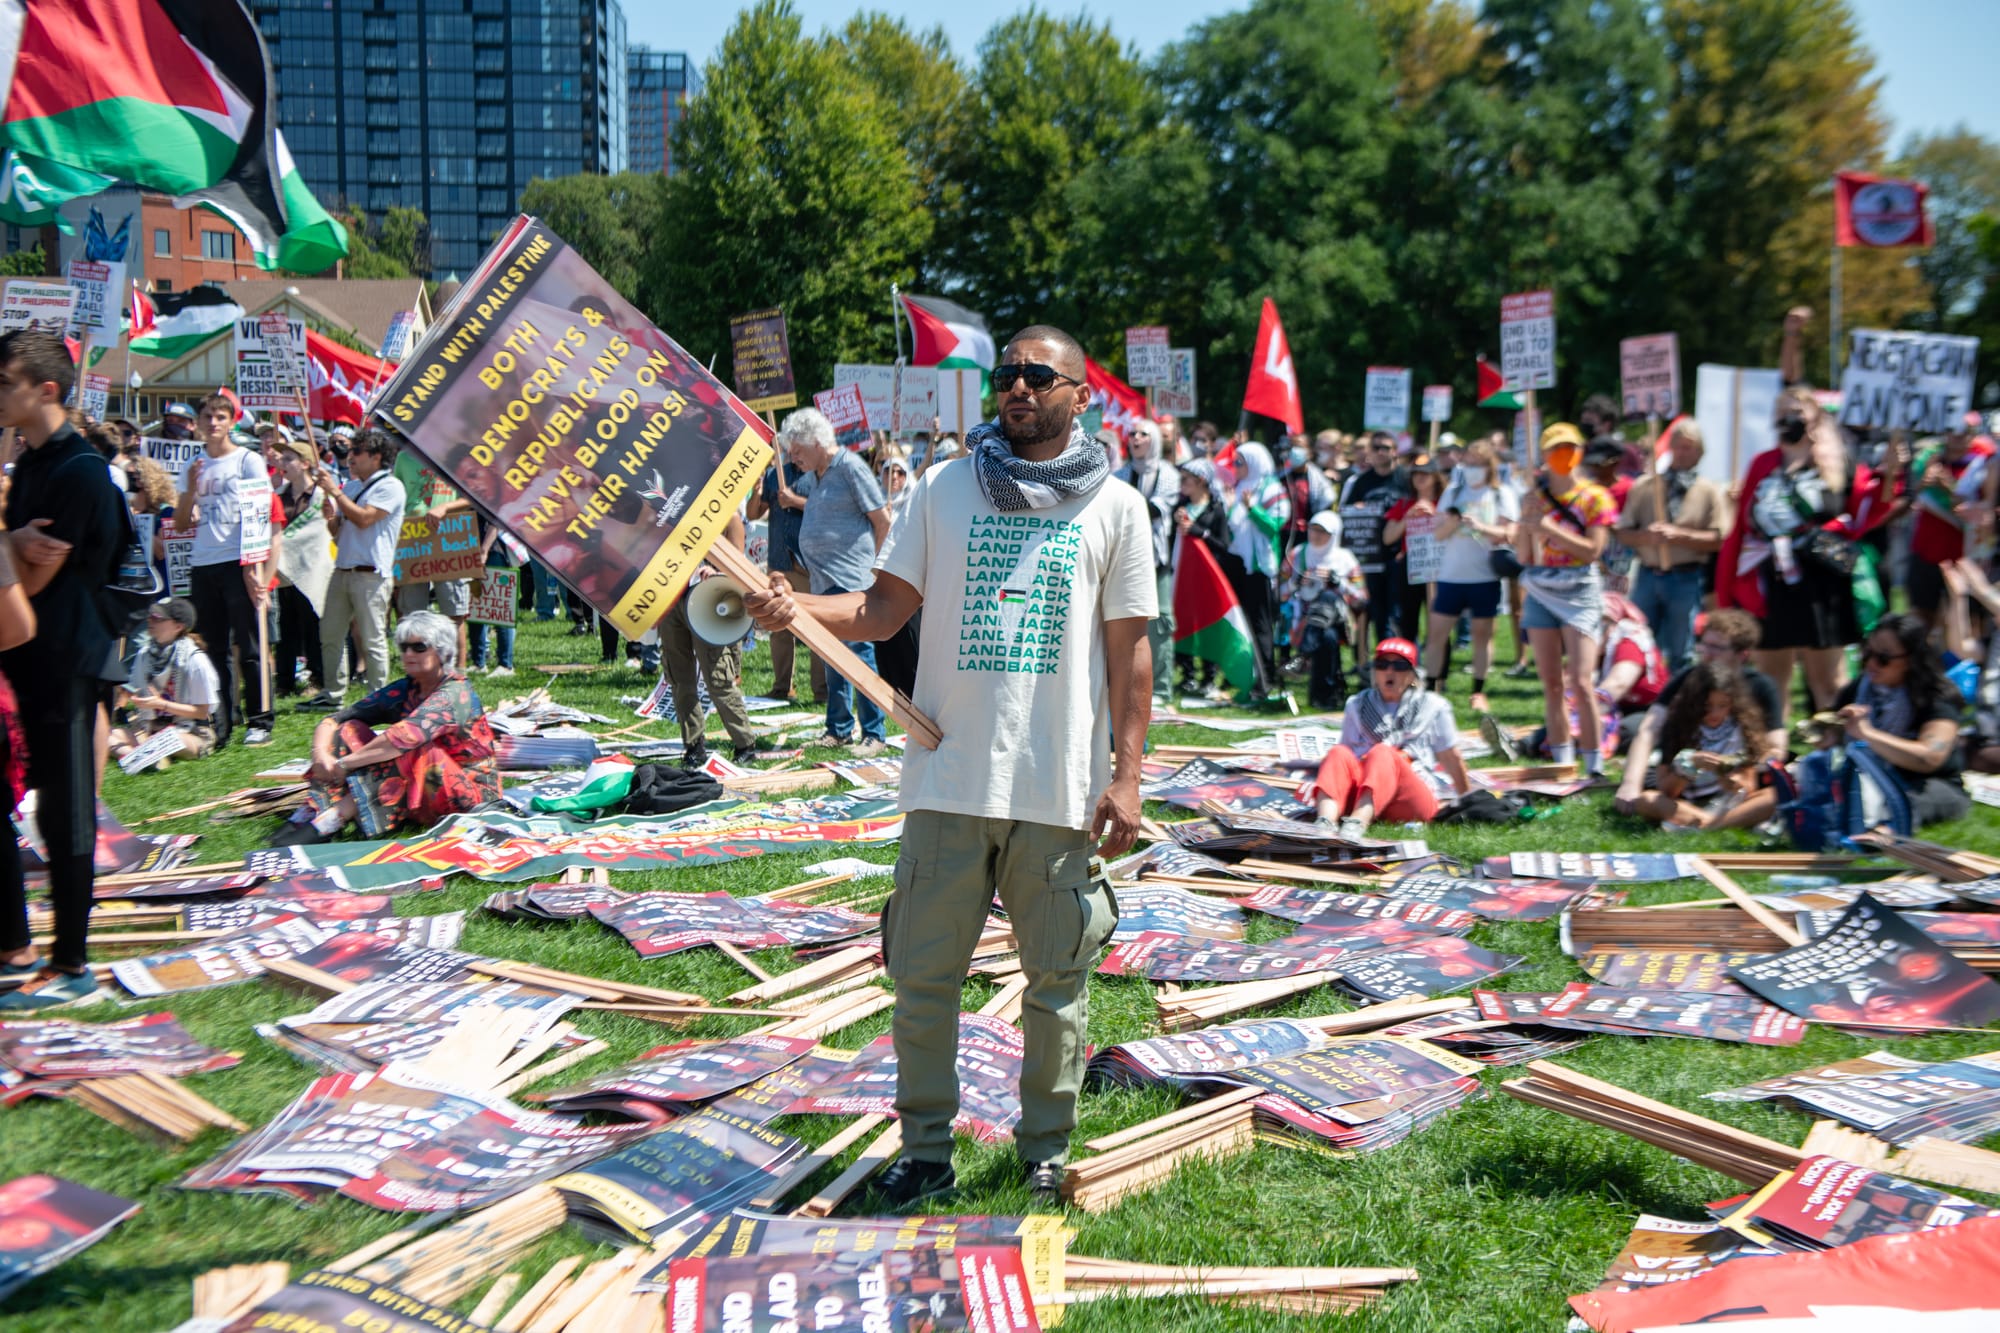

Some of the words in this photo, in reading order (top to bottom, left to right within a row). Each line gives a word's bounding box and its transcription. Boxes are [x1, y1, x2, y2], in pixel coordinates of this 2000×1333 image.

[2, 310, 30, 319] STOP
[394, 363, 447, 421] STAND
[440, 316, 486, 363] WITH
[476, 233, 553, 321] PALESTINE
[1503, 325, 1524, 339] END
[478, 319, 541, 391] BOTH
[1504, 341, 1525, 354] AID
[1530, 338, 1549, 350] TO
[1130, 357, 1148, 366] AID
[1153, 355, 1166, 364] TO
[838, 368, 871, 381] STOP
[469, 325, 588, 467] DEMOCRATS
[582, 307, 605, 328] &
[504, 335, 631, 491] REPUBLICANS
[524, 465, 584, 532] HAVE
[574, 388, 640, 469] BLOOD
[636, 349, 671, 387] ON
[566, 473, 629, 540] THEIR
[619, 389, 689, 476] HANDS!
[626, 588, 657, 623] END
[654, 558, 683, 587] U.S.
[679, 526, 703, 555] AID
[700, 498, 721, 524] TO
[718, 445, 760, 499] ISRAEL
[972, 515, 1083, 535] LANDBACK
[441, 533, 478, 552] back
[967, 542, 1078, 561] LANDACK
[410, 552, 484, 578] GENOCIDE
[477, 607, 515, 623] ISRAEL
[964, 600, 1069, 617] LANACK
[959, 644, 1060, 660] LANDBACK
[957, 659, 1058, 674] LANDBACK
[1275, 1083, 1322, 1108] STAND
[299, 1271, 372, 1295] STAND
[368, 1286, 426, 1317] WITH
[814, 1296, 845, 1331] TO
